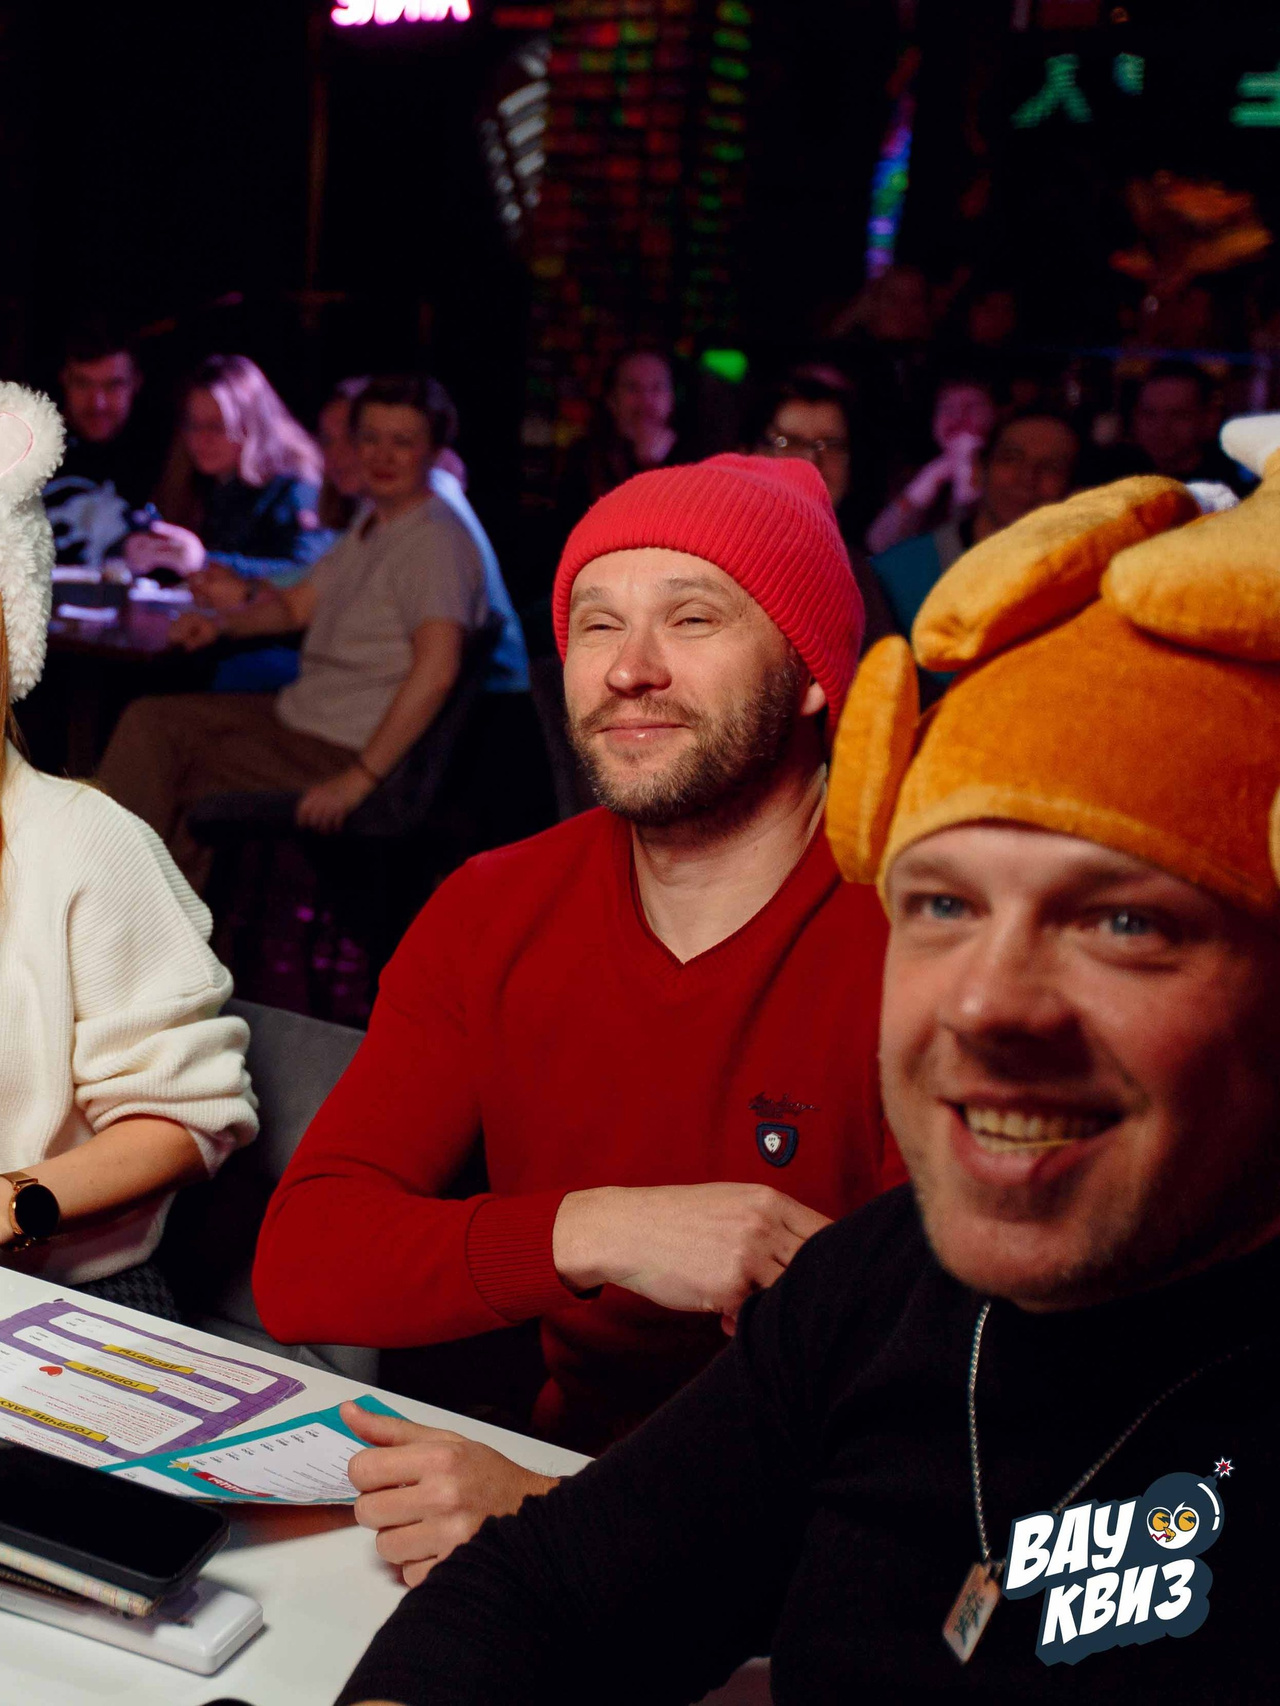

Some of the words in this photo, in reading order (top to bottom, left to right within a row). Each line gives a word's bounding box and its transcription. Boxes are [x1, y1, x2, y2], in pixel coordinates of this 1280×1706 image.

[119, 1347, 180, 1370] ДЕСЕРТЫ
[81, 1365, 141, 1388] ГОРЯЧЕЕ
[37, 1410, 94, 1437] ГОРЯЧИЕ
